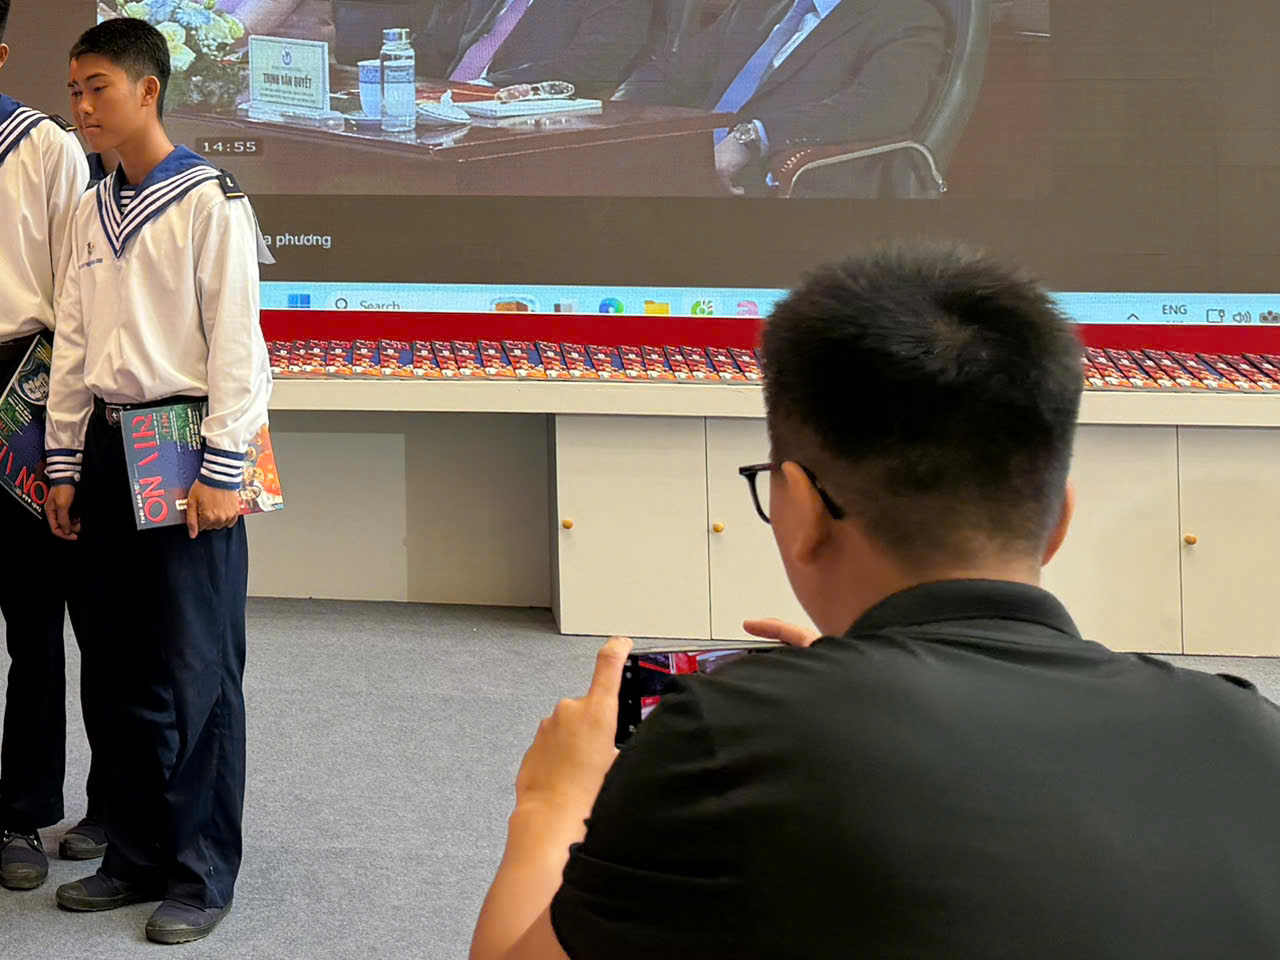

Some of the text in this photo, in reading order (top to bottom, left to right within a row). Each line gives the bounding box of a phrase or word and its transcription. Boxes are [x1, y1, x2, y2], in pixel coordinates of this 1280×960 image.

[203, 141, 256, 153] 14:55
[276, 233, 332, 249] phương
[1162, 305, 1188, 316] ENG
